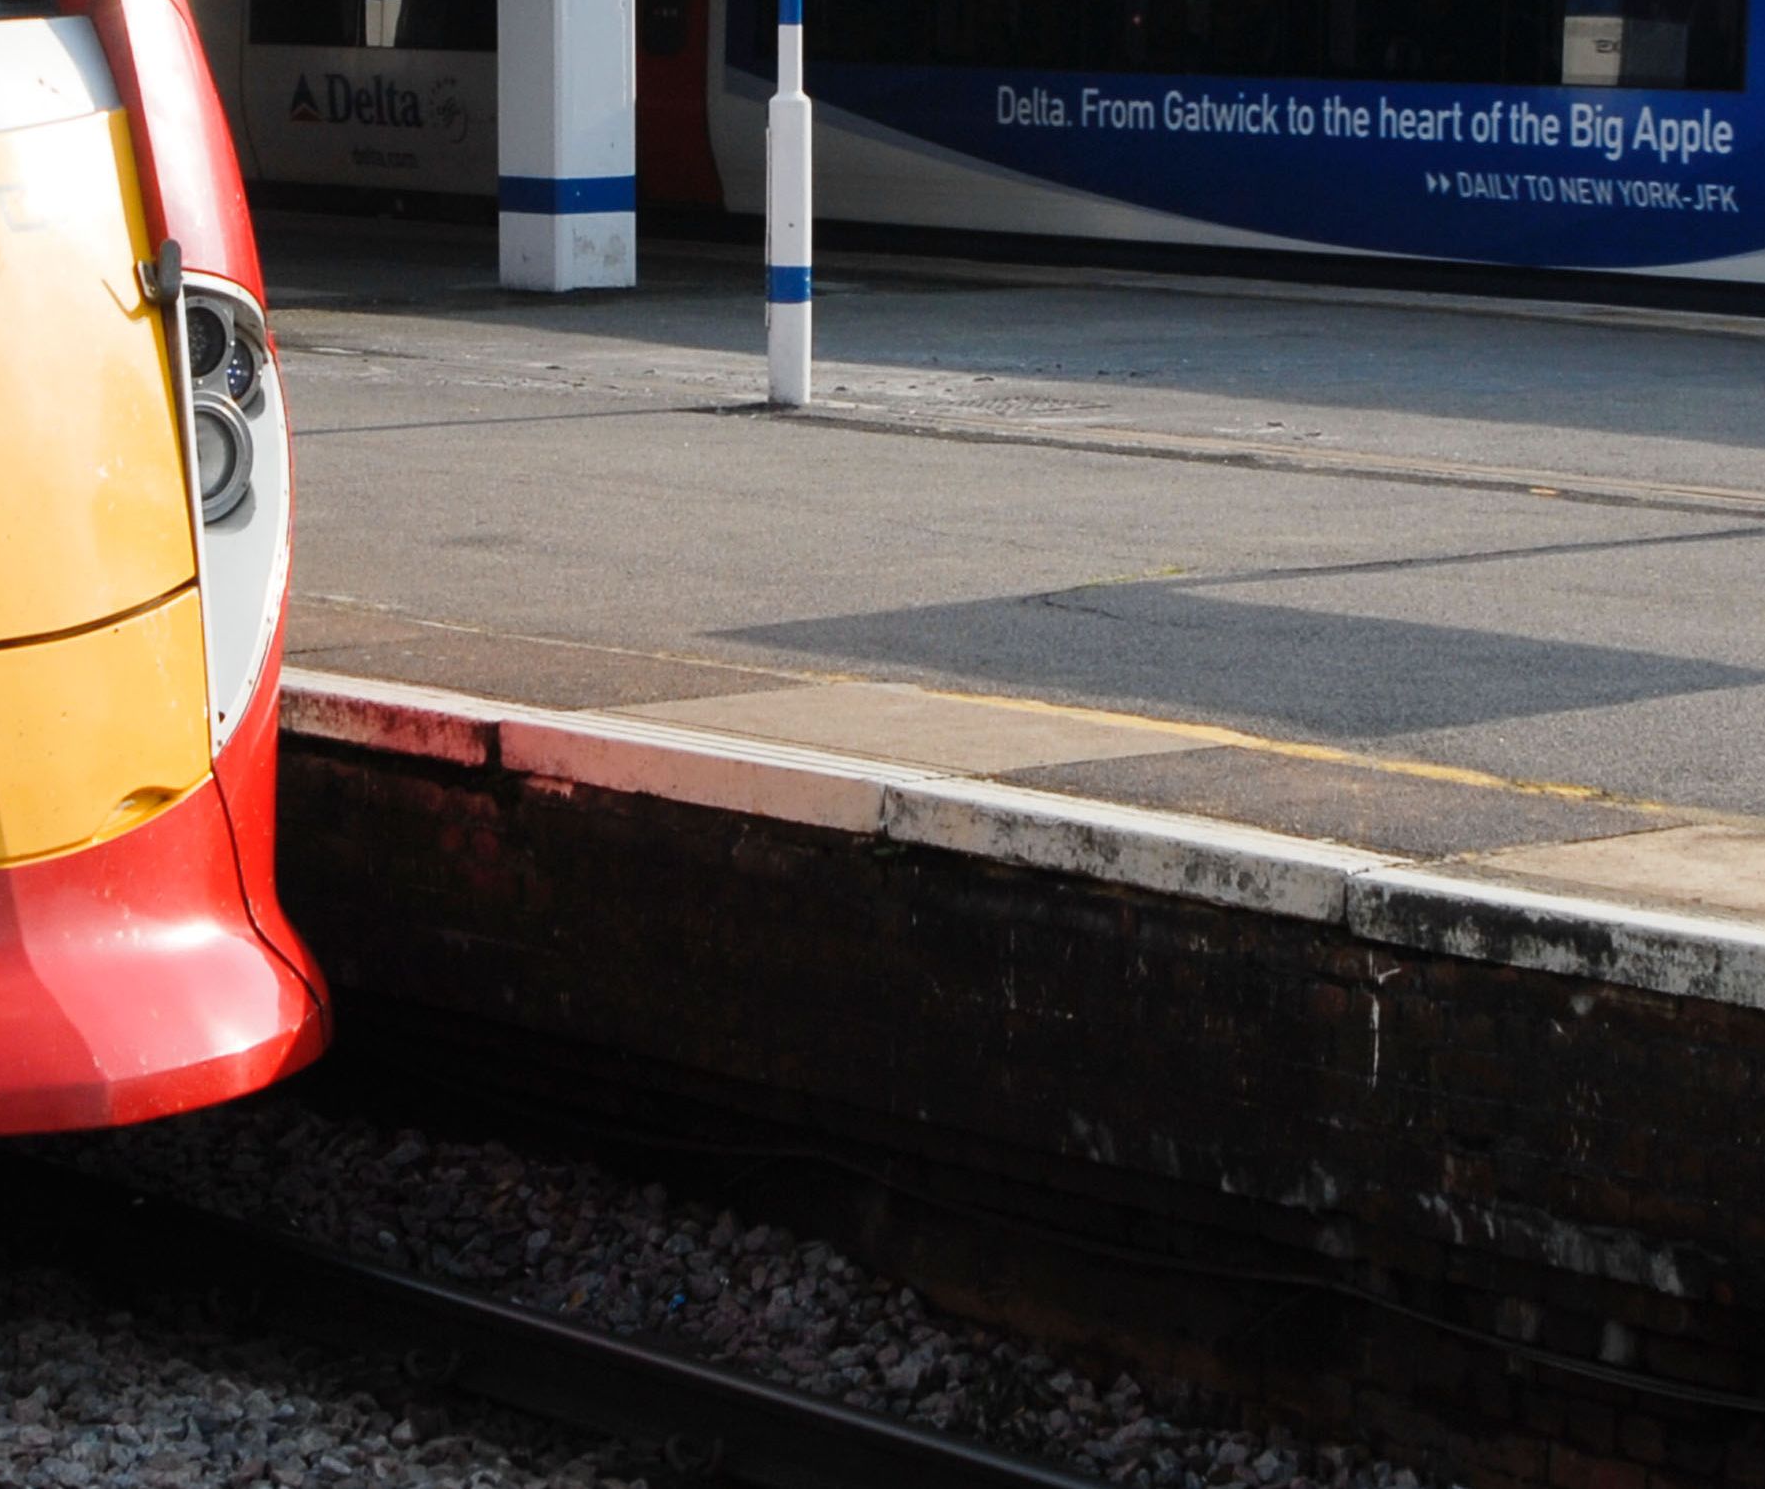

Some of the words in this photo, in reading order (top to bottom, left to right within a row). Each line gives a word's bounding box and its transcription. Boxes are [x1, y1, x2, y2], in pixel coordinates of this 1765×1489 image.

[325, 73, 424, 128] Delta
[997, 86, 1073, 127] Delta.
[1081, 87, 1155, 130] From
[1163, 90, 1280, 135] Gatwick
[1287, 96, 1315, 136] to
[1323, 95, 1371, 138] the
[1379, 96, 1463, 142] heart
[1470, 100, 1503, 144] of
[1509, 101, 1561, 147] the
[1570, 103, 1624, 162] Big
[1632, 106, 1734, 164] Apple
[1456, 171, 1520, 200] DAILY
[1524, 175, 1555, 202] TO
[1559, 176, 1614, 206] NEW
[1618, 180, 1740, 213] YORK-JFK
